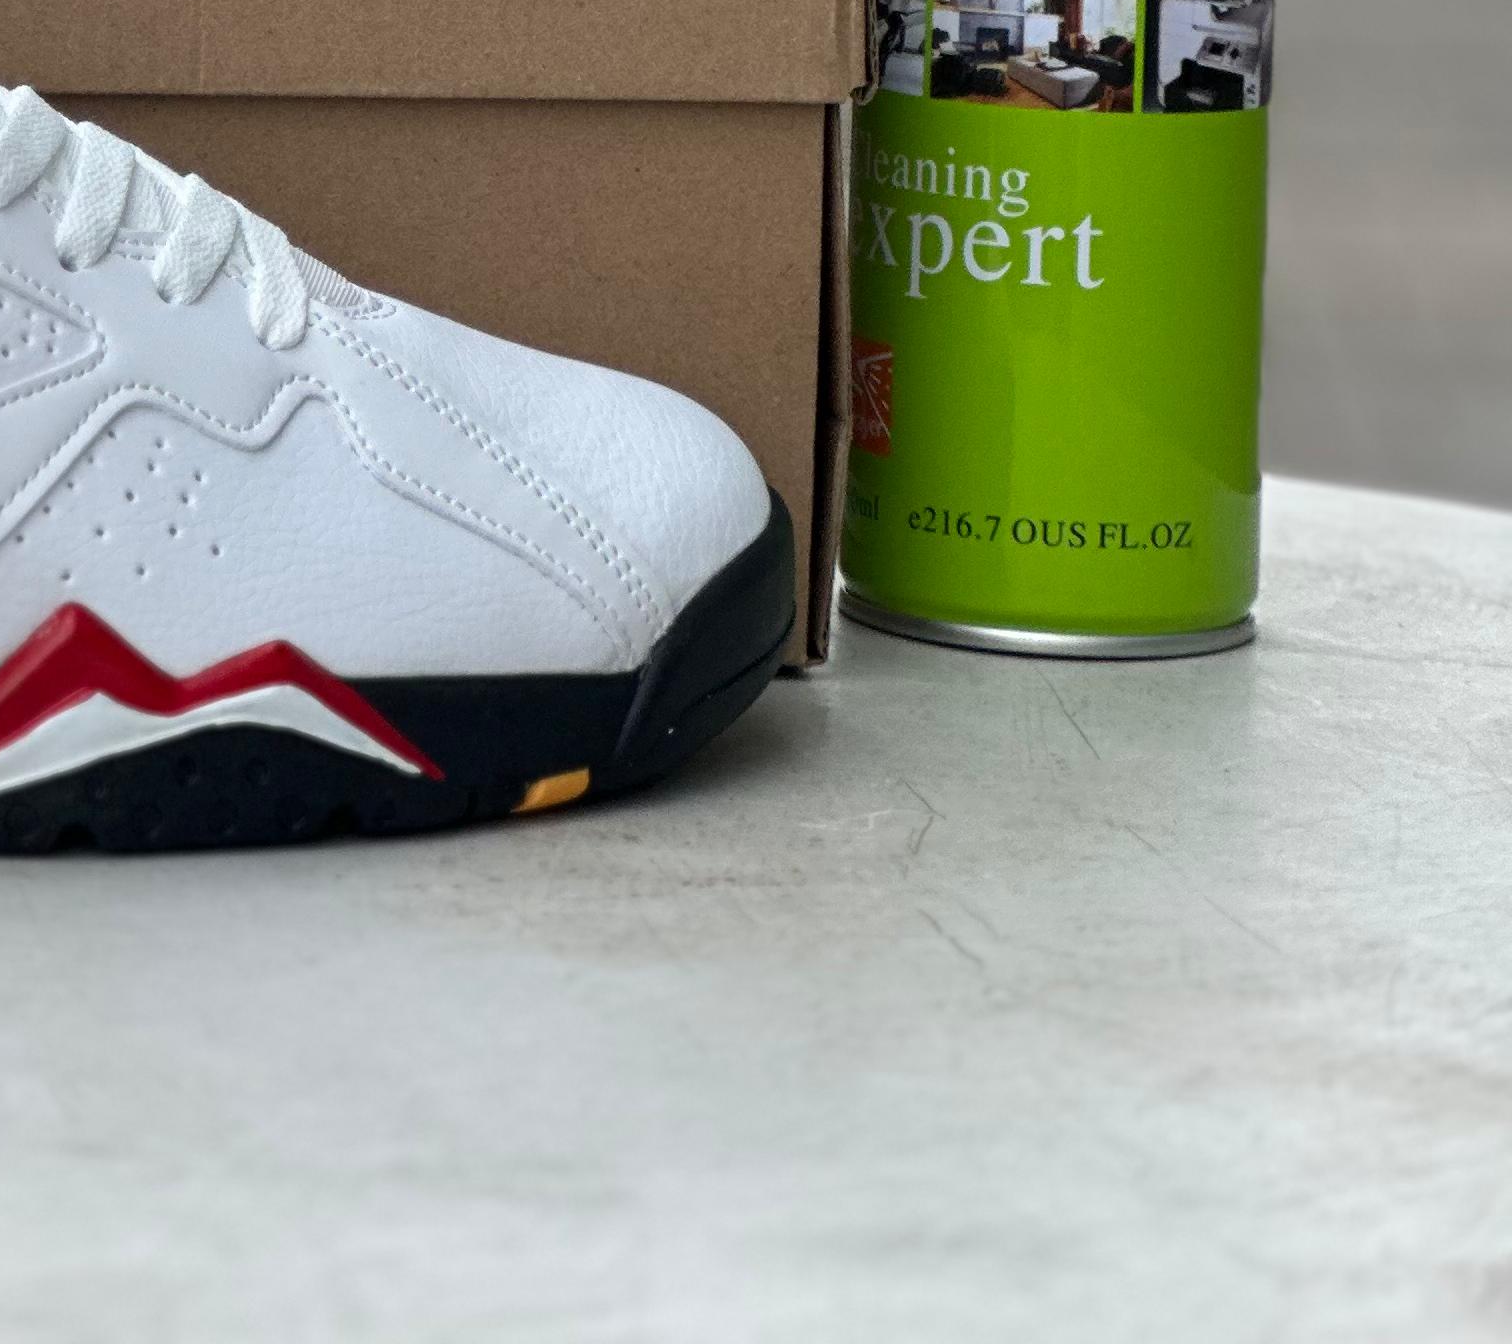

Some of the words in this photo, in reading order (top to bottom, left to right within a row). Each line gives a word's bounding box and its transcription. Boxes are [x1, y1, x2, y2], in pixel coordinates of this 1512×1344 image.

[907, 506, 1001, 542] e216.7
[1012, 517, 1087, 549] OUS
[1098, 520, 1192, 551] FL.OZ
